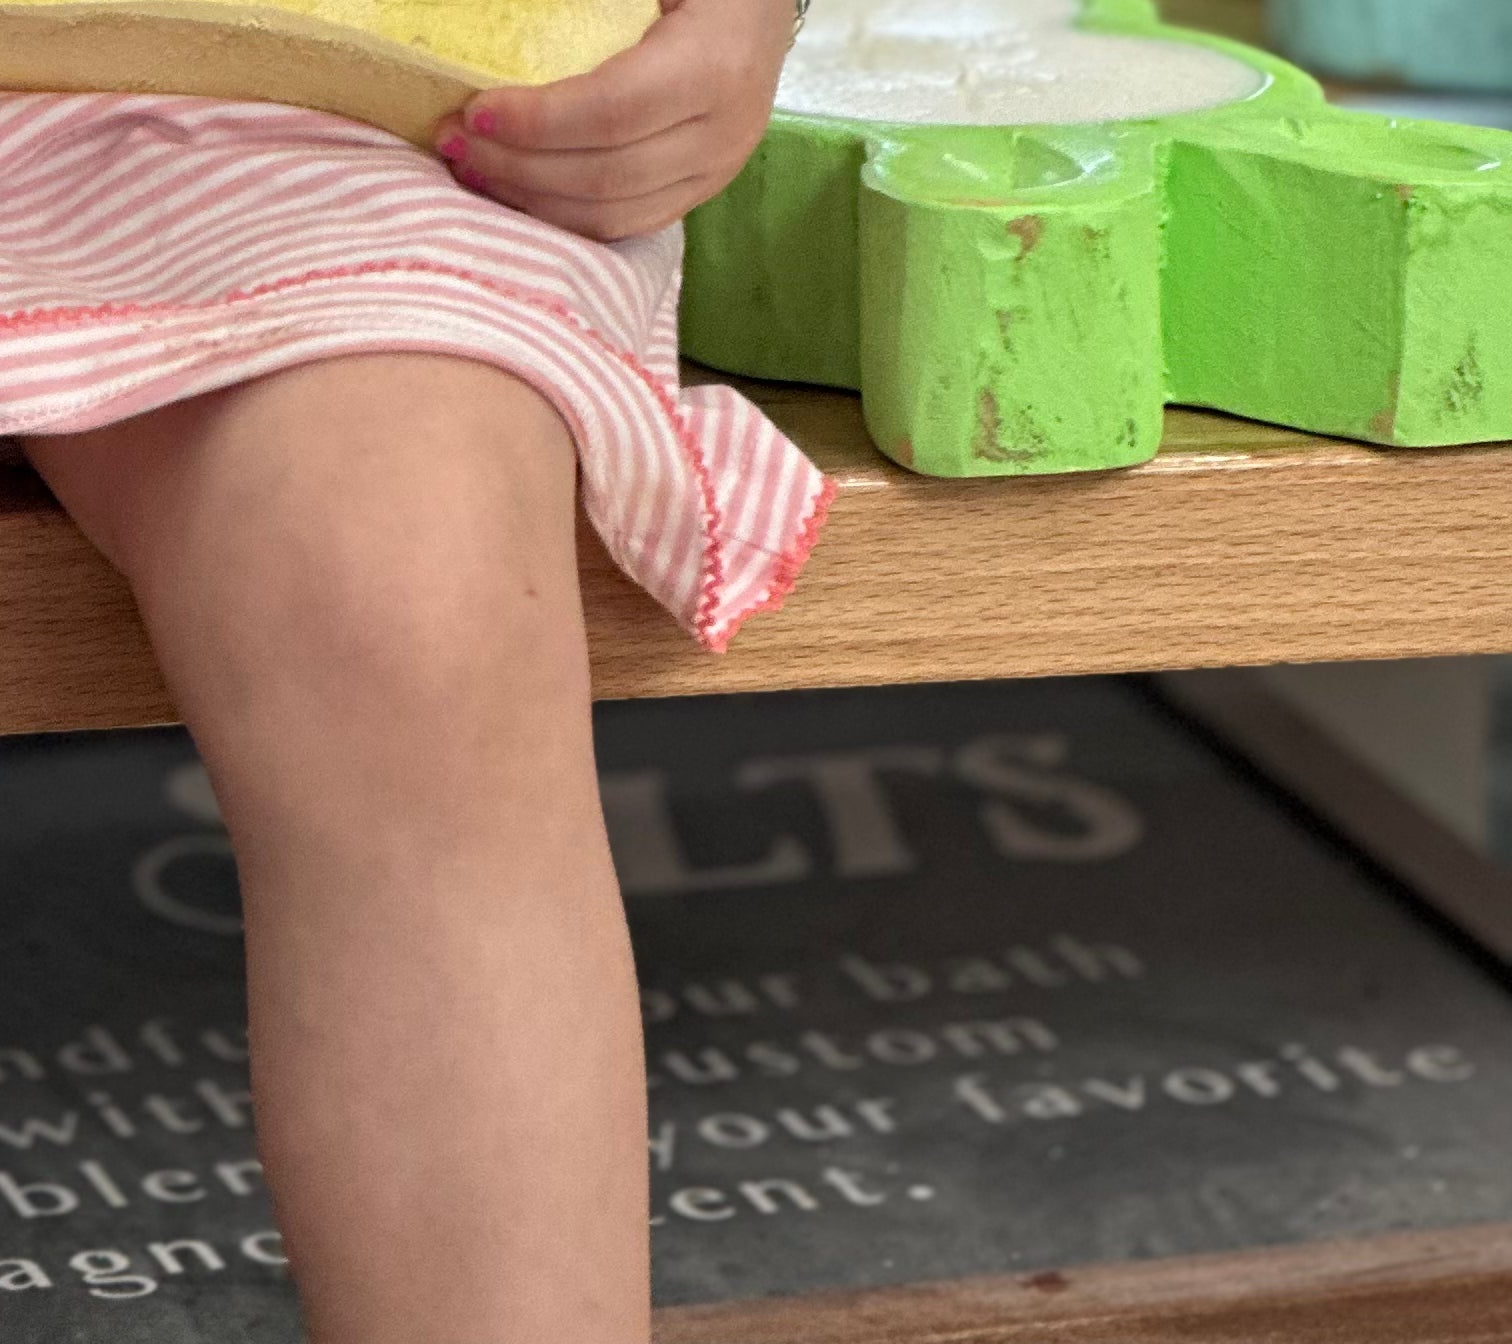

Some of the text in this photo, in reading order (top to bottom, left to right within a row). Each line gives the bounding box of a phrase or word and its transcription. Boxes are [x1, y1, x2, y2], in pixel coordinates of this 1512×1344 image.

[841, 933, 1145, 1002] bath
[647, 1015, 1059, 1089] ustom
[953, 1043, 1476, 1124] favorite
